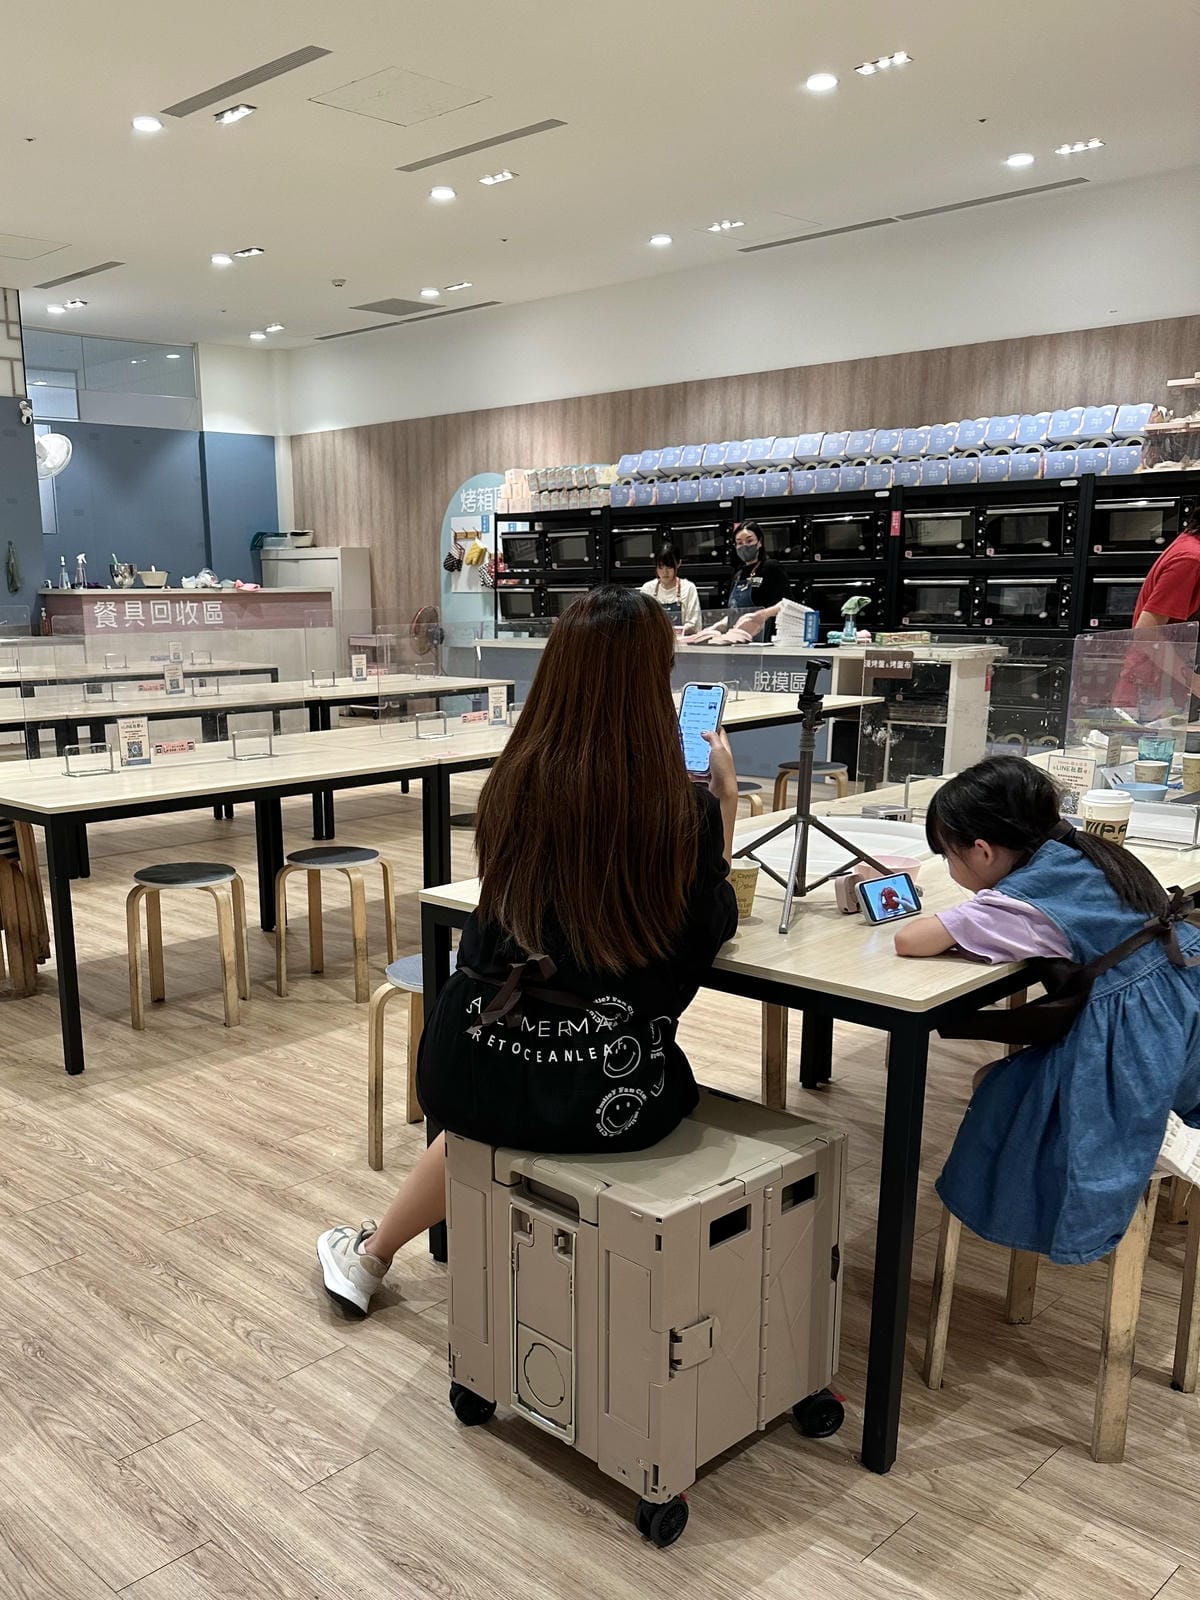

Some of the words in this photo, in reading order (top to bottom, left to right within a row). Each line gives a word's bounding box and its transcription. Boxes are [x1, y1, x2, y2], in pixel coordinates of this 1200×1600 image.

[93, 599, 224, 628] 餐具回收區
